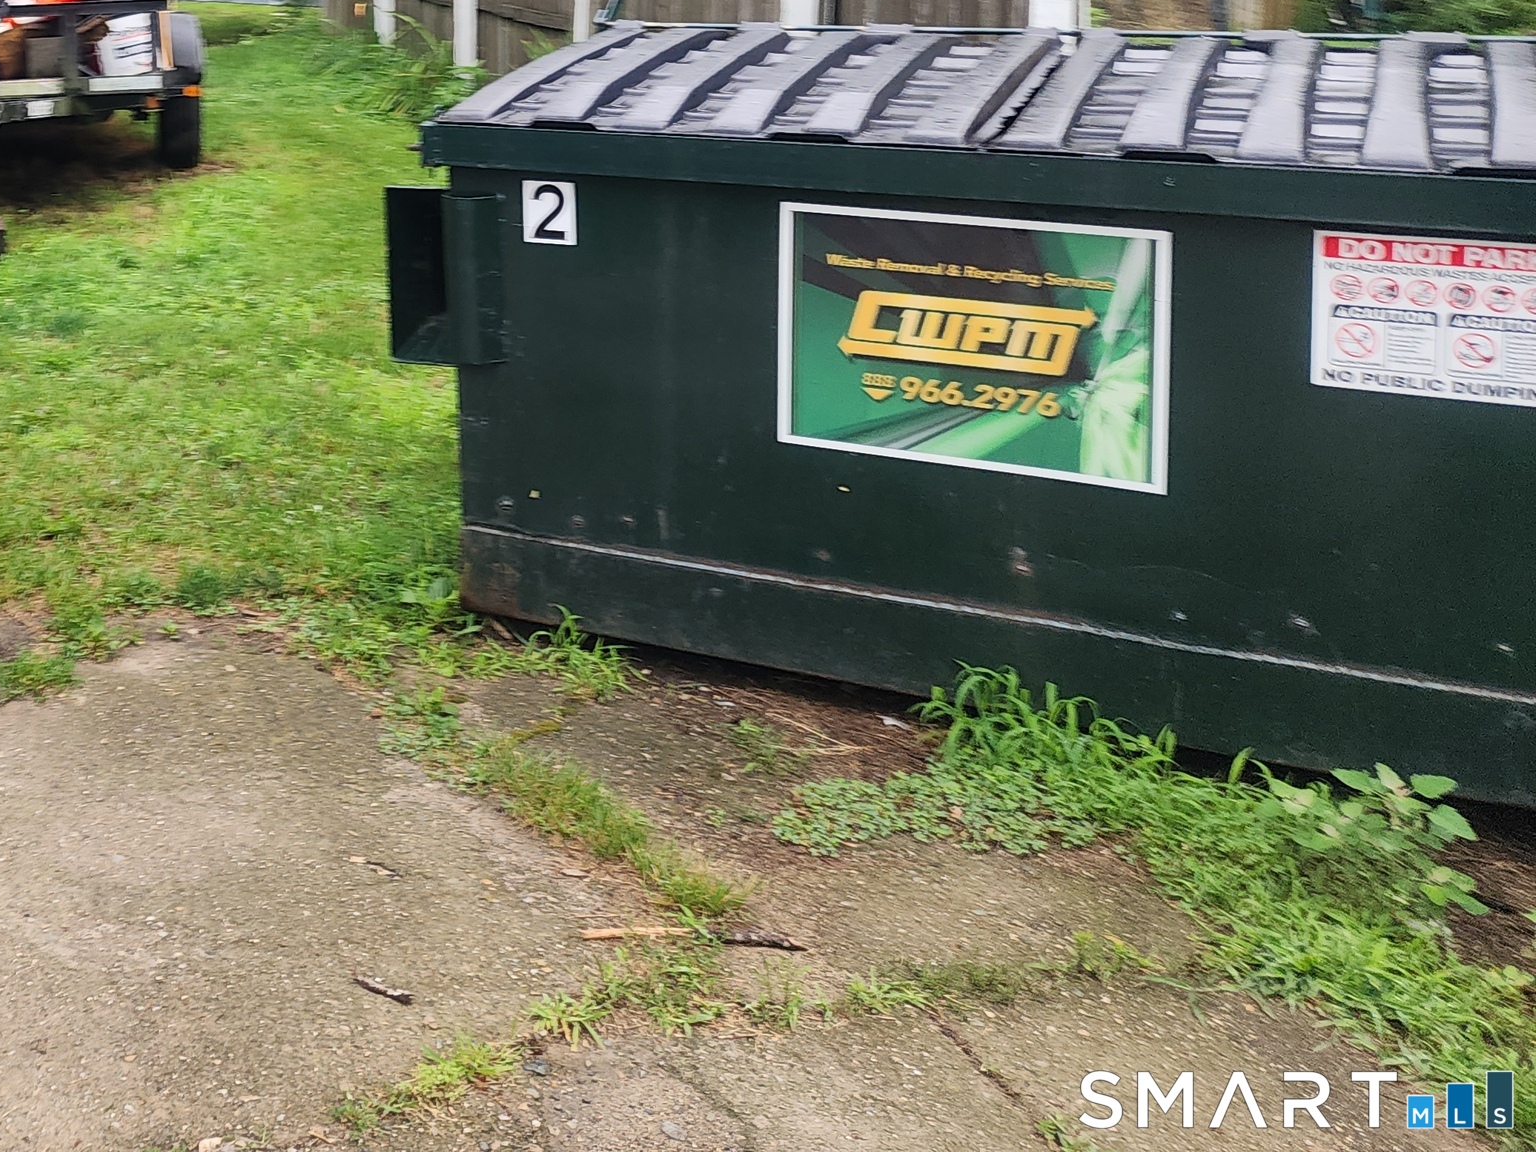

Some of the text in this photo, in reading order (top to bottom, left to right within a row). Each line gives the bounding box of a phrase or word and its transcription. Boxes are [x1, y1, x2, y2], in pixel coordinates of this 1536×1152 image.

[533, 183, 565, 241] 2
[1337, 238, 1388, 261] DO
[1392, 241, 1459, 264] NOT
[825, 253, 1115, 292] Waste Removal & Recycling Services
[837, 290, 1099, 376] CWPM
[1349, 307, 1436, 326] CAUTION
[899, 376, 1062, 417] 966.2976
[1322, 368, 1353, 383] NO
[1360, 372, 1446, 392] PUBLIC
